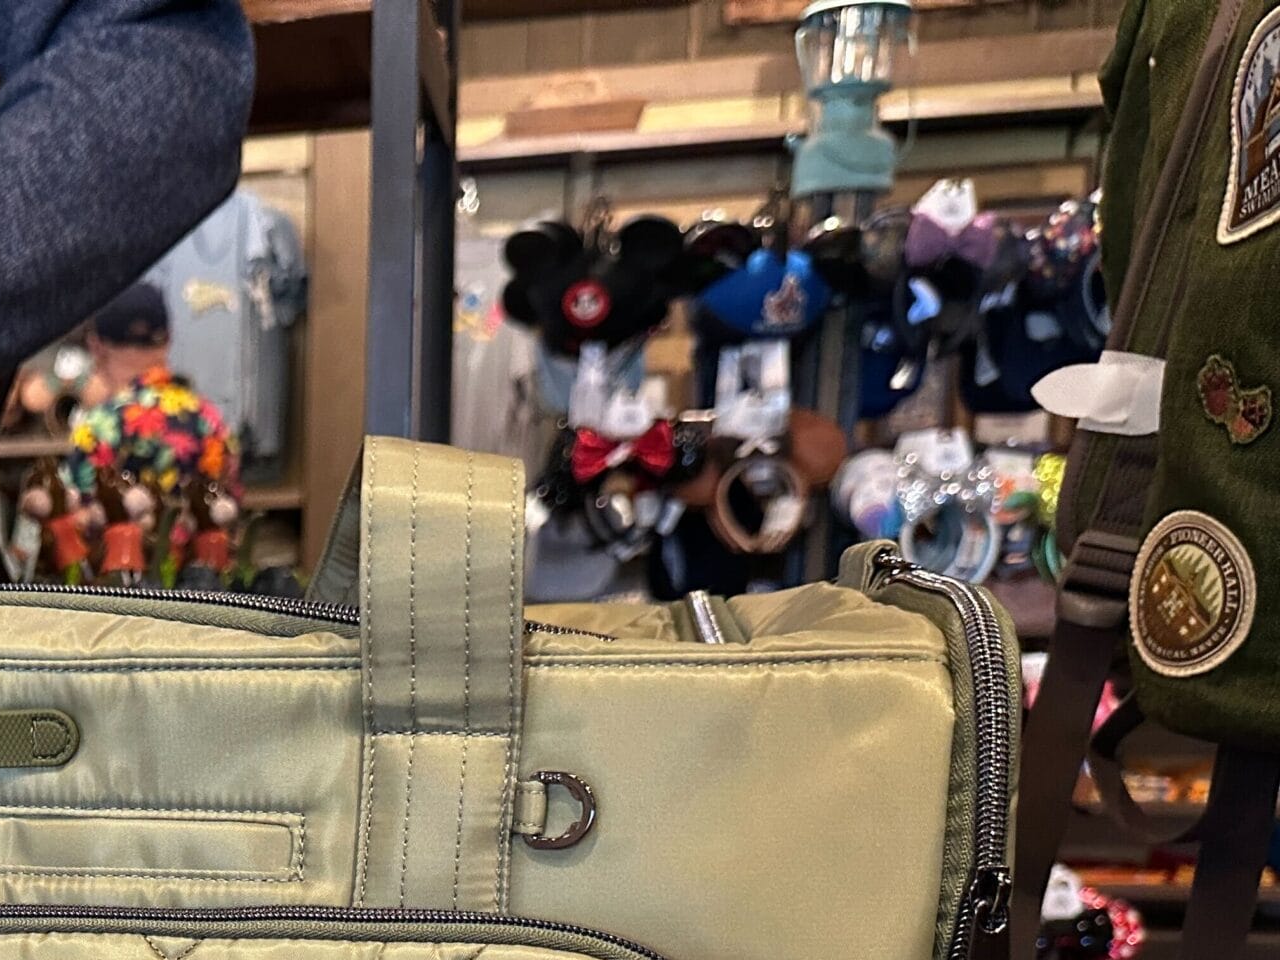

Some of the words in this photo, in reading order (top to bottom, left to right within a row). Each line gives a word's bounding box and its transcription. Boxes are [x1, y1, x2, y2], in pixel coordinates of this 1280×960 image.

[1244, 152, 1280, 203] MEA
[1170, 528, 1225, 562] PIONEER
[1222, 561, 1239, 613] HALL
